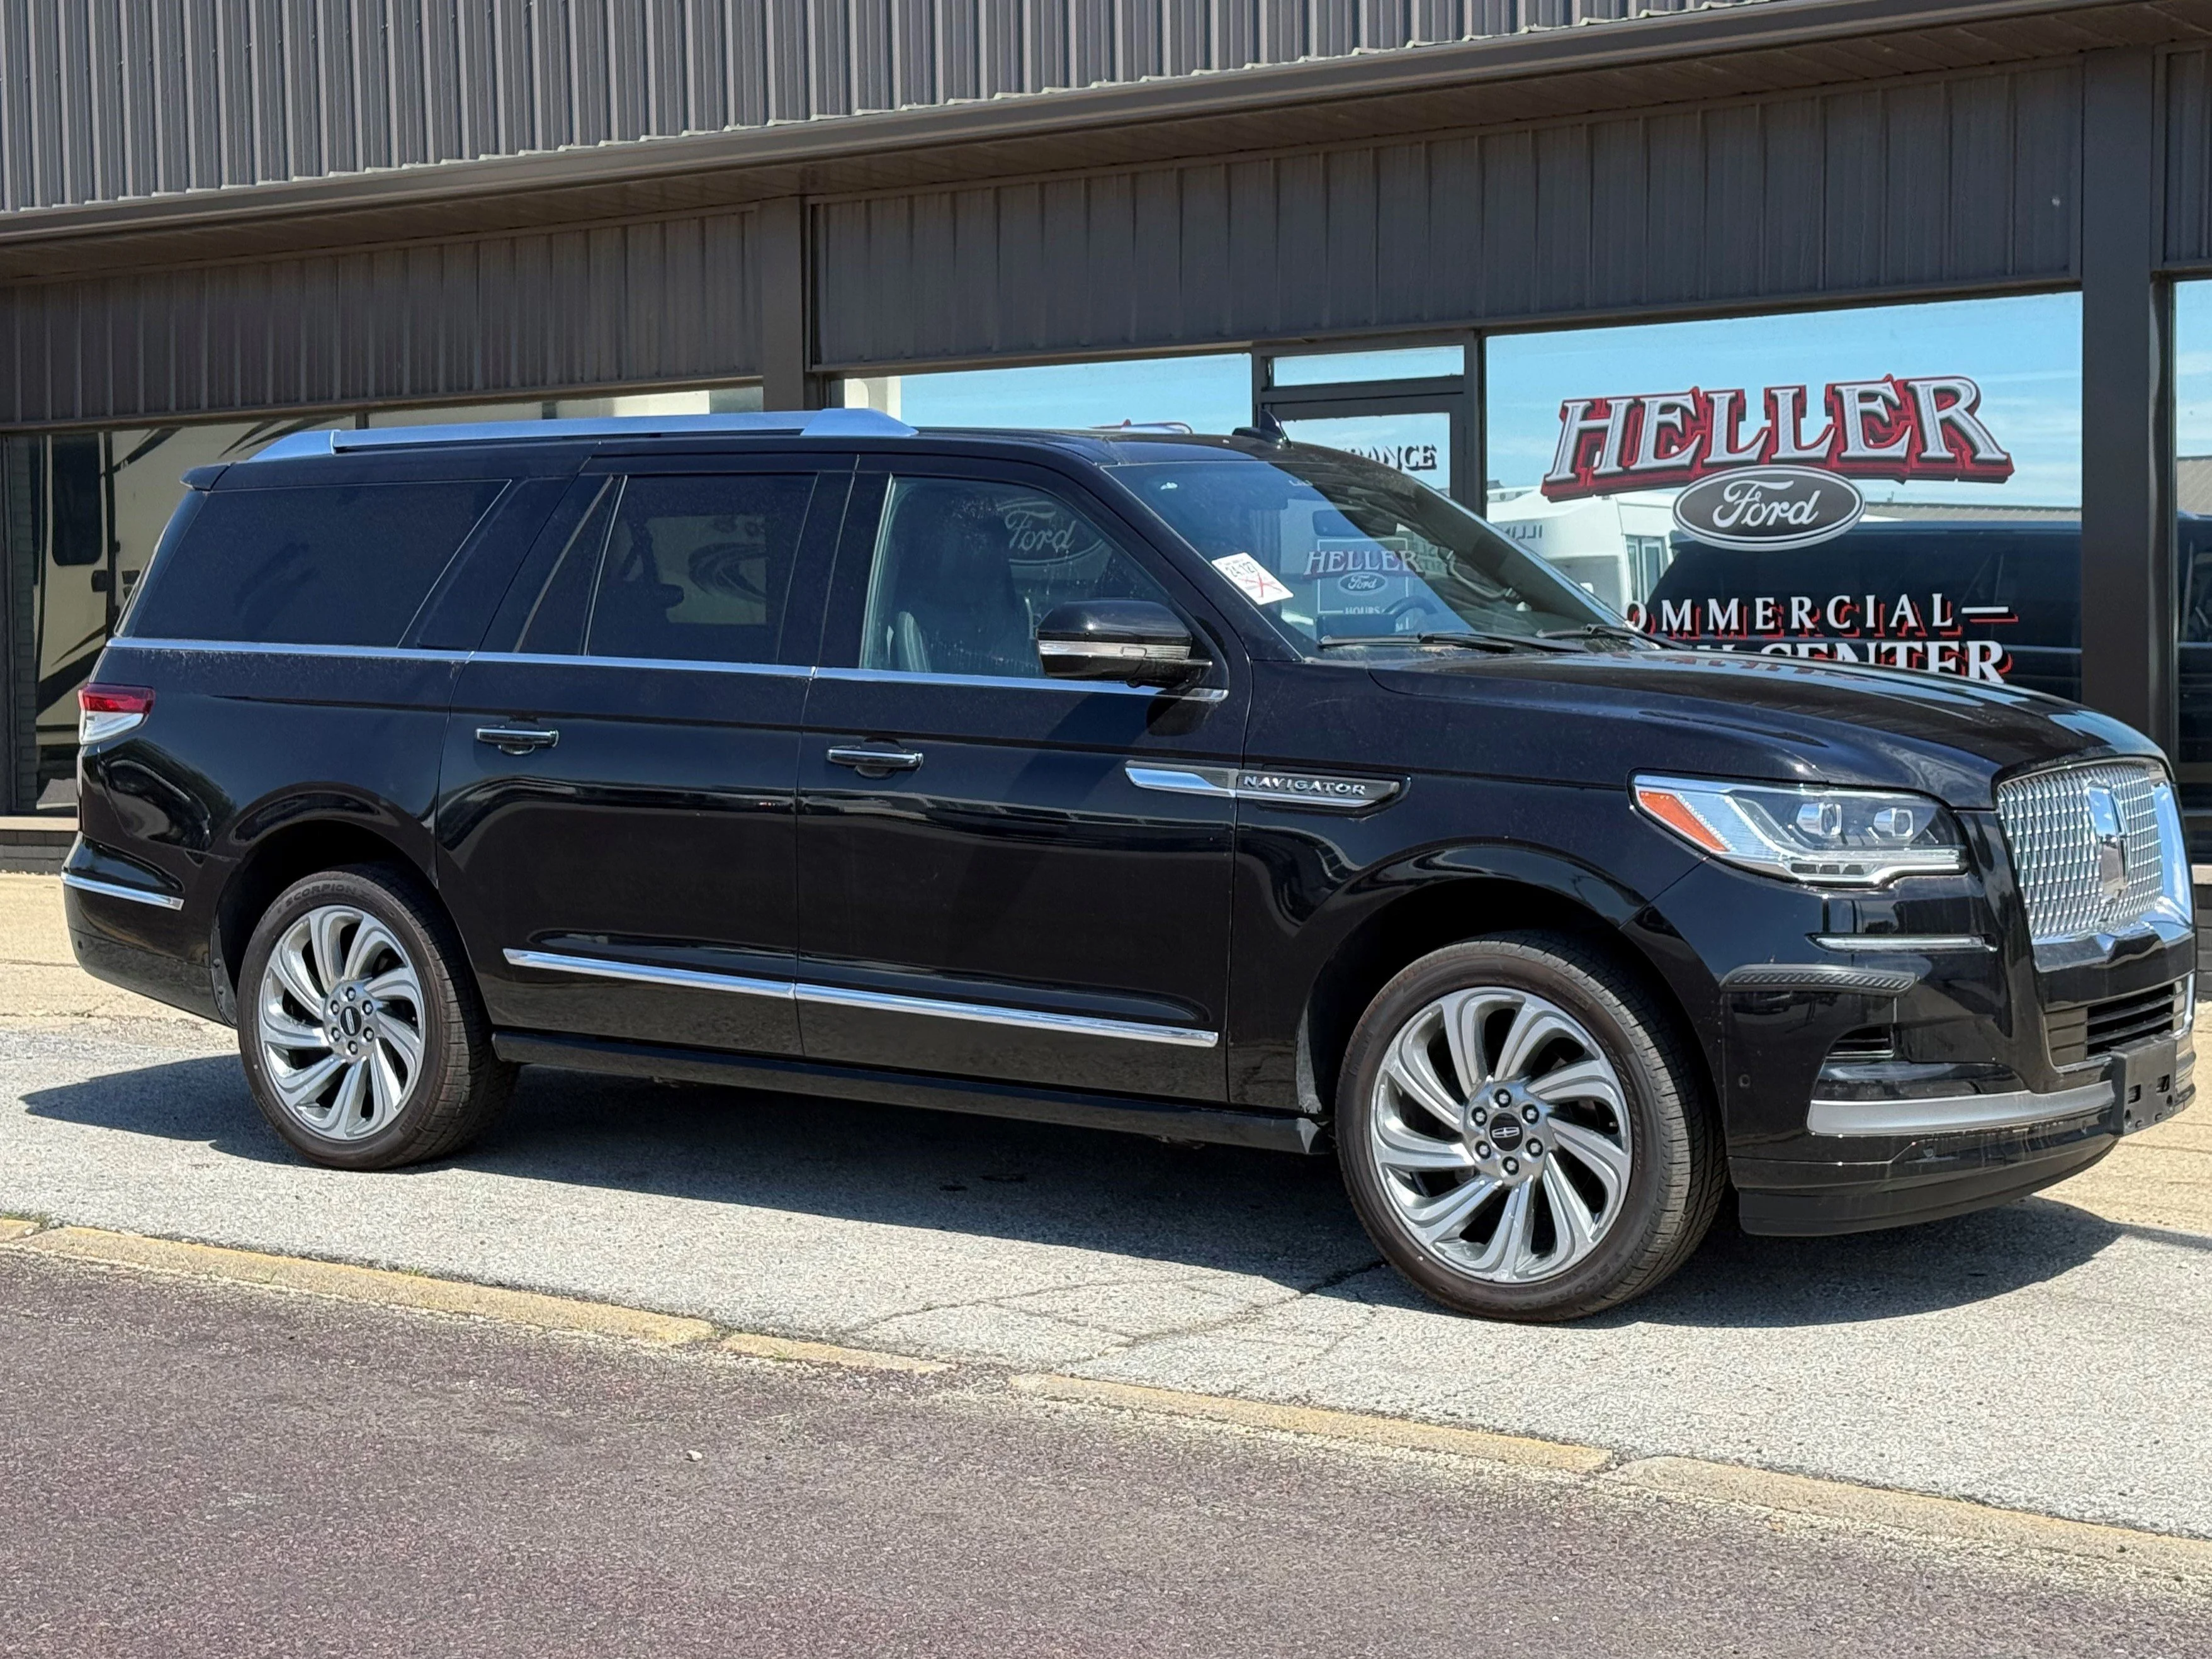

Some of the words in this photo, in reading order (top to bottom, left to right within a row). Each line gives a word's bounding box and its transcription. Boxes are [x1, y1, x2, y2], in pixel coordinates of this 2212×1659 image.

[1542, 374, 2013, 496] HELLER
[1712, 479, 1820, 528] Ford
[1005, 510, 1076, 551] Ford
[1302, 549, 1425, 578] HELLER
[1348, 575, 1378, 590] Ford
[1623, 593, 1953, 634] OMMERCIAL
[1243, 775, 1366, 796] NAVIGATOR
[285, 883, 357, 907] SCORPION
